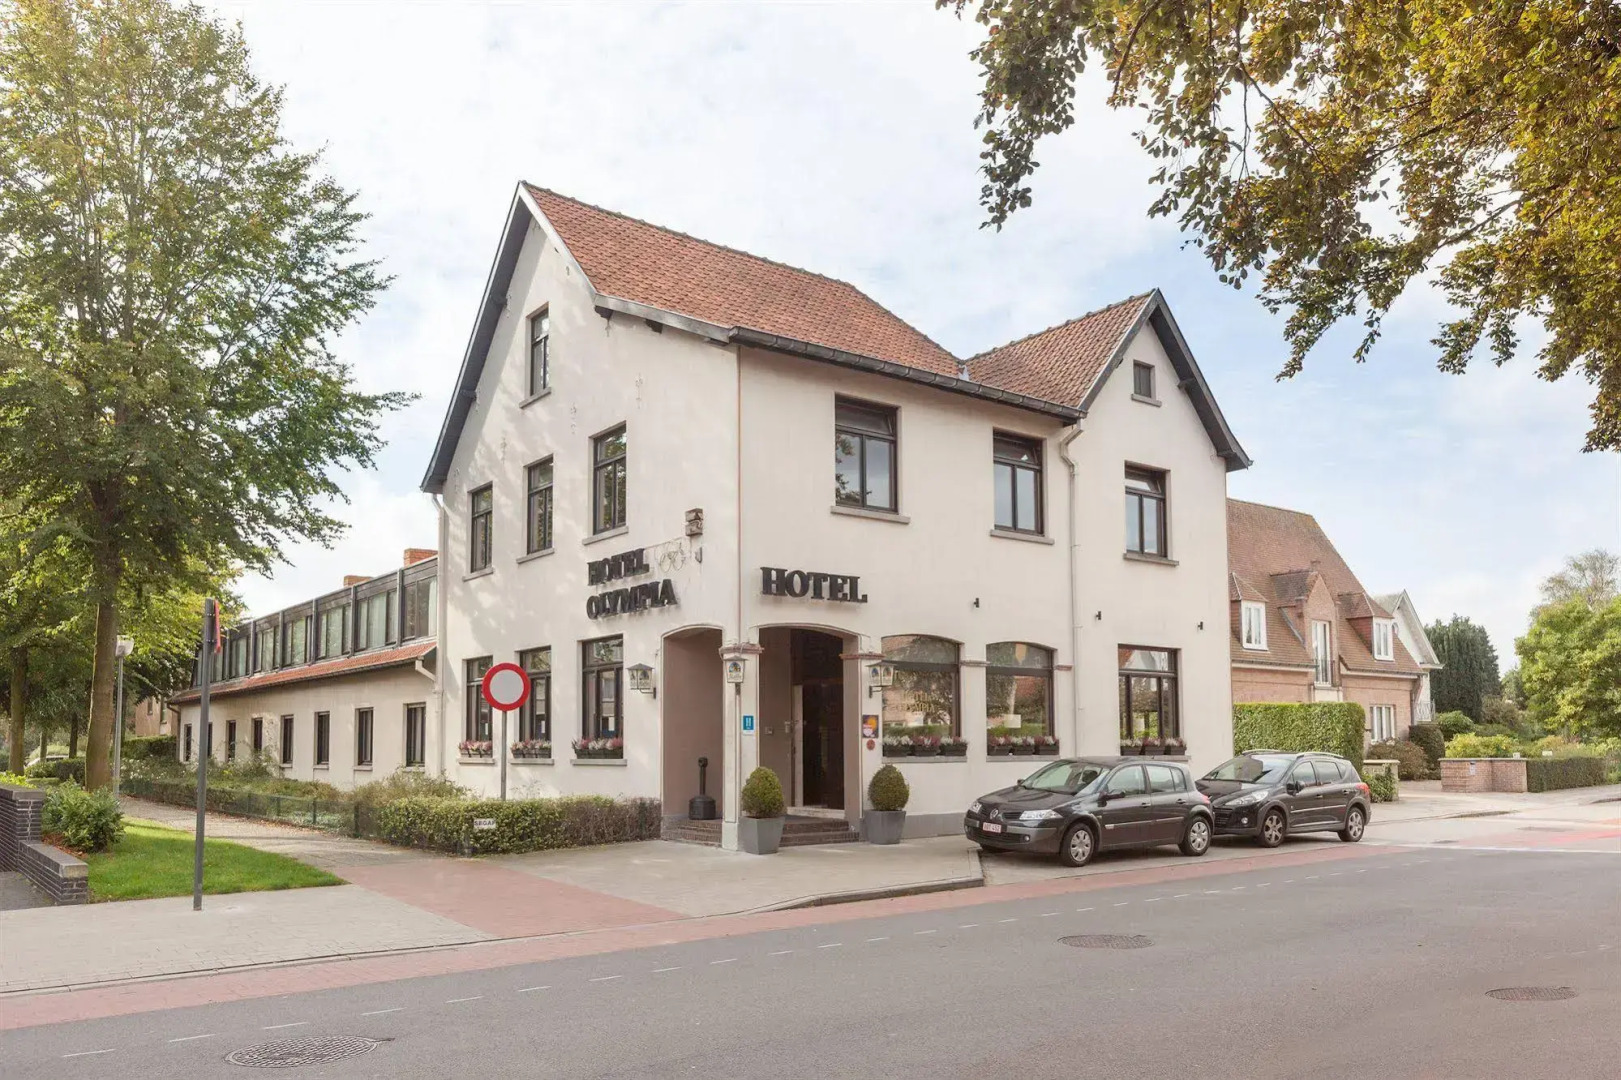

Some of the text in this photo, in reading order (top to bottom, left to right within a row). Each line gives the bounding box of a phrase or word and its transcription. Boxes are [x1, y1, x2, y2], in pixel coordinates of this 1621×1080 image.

[587, 548, 649, 586] HOTEL
[760, 567, 867, 603] HOTEL
[586, 579, 678, 619] OLYMPIA
